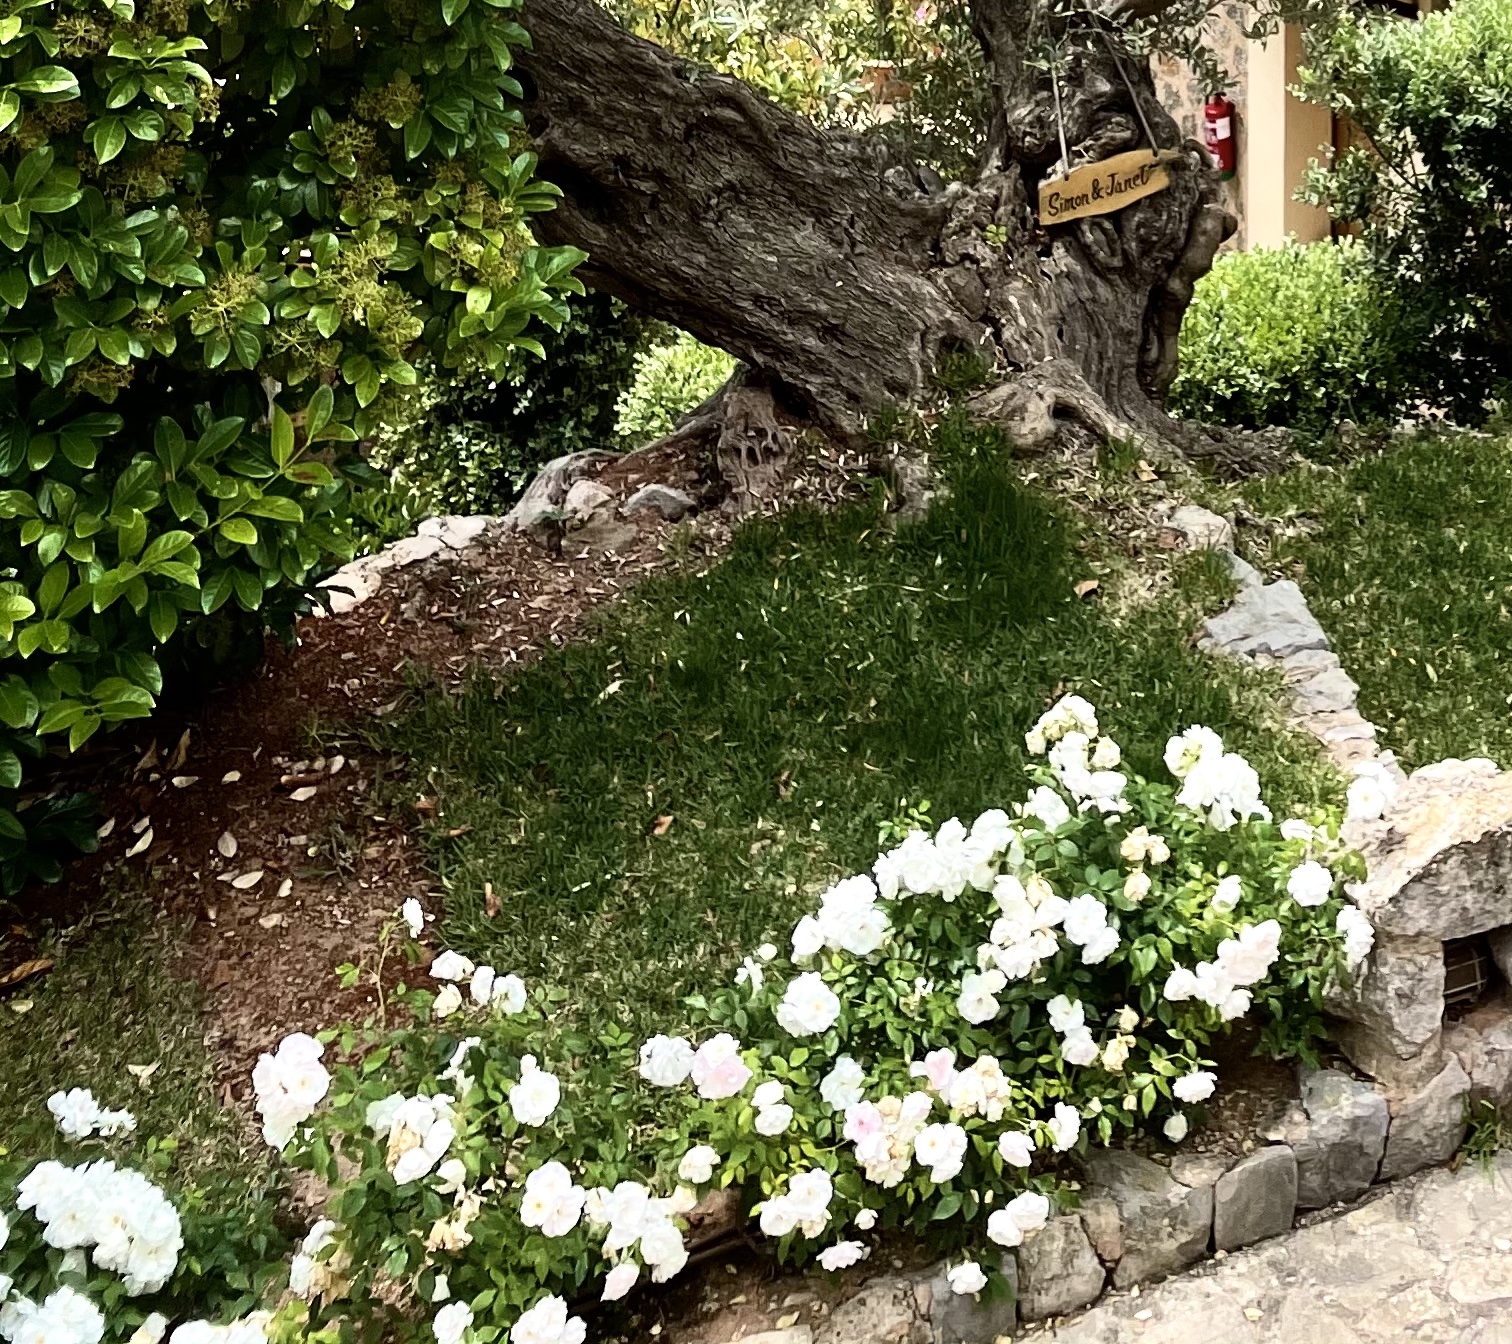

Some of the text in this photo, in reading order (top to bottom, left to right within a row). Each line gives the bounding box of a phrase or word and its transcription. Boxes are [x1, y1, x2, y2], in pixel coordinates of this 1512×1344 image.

[1048, 163, 1151, 216] Simon & Janet
